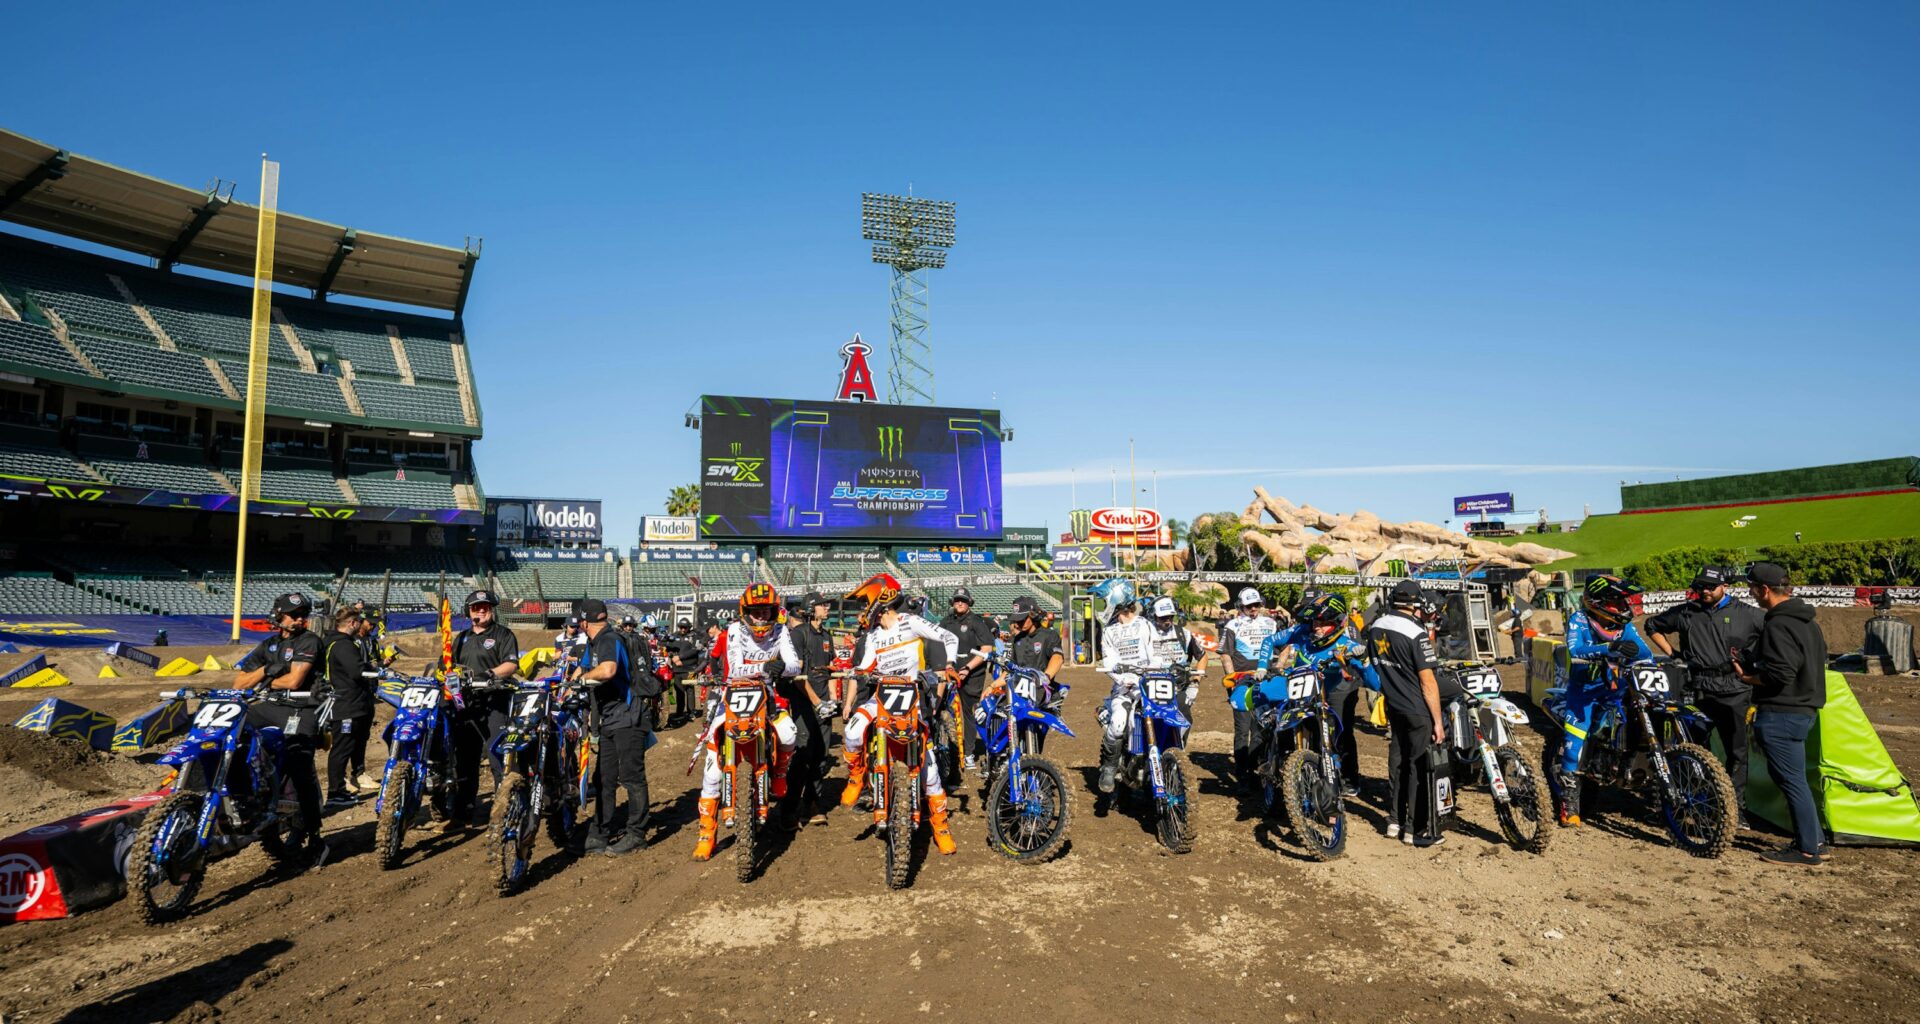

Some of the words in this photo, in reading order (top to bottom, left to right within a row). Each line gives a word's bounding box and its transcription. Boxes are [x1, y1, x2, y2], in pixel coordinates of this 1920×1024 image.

[706, 462, 761, 482] SMX
[860, 467, 920, 478] MONSTER
[830, 487, 949, 501] SUPERCROSS
[527, 503, 596, 528] Modelo
[857, 501, 924, 511] CHAMPIONSHIP
[652, 520, 690, 535] Modelo
[1103, 514, 1150, 525] Yakult
[534, 551, 552, 559] Modelo
[558, 551, 576, 559] Modelo
[581, 551, 600, 559] Modelo
[653, 552, 671, 560] Modelo
[1055, 546, 1104, 565] SMX
[1146, 679, 1173, 700] 19
[1288, 674, 1315, 700] 61
[1467, 674, 1500, 693] 34
[1638, 670, 1670, 692] 23
[400, 687, 440, 710] 154
[729, 691, 762, 713] 57
[882, 688, 914, 710] 71
[193, 703, 242, 727] 42
